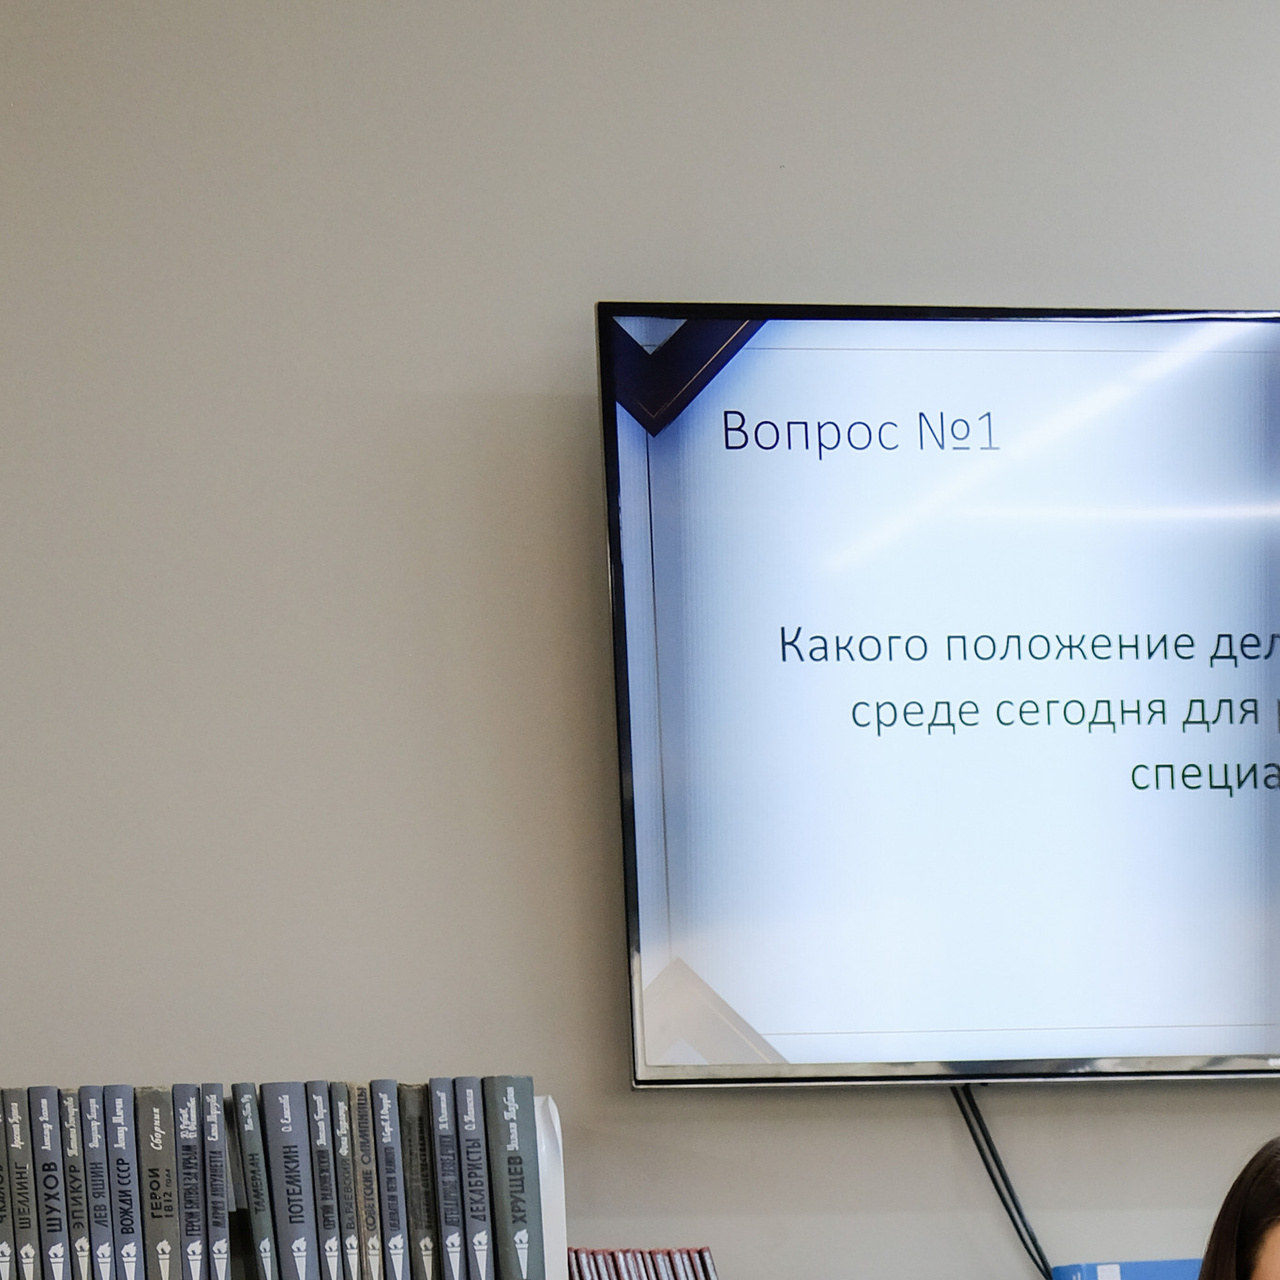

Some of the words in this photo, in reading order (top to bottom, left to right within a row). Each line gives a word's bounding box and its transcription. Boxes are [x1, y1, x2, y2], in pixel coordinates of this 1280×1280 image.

[724, 411, 900, 463] Вопрос
[919, 412, 1000, 452] №1
[780, 627, 928, 663] Какого
[947, 633, 1196, 663] положение
[851, 696, 982, 734] среде
[996, 697, 1168, 732] сегодня
[1182, 697, 1260, 732] для
[15, 1162, 31, 1229] ШЕЛЛИНГ
[43, 1162, 62, 1232] ШУХОВ
[69, 1165, 84, 1229] ЭПИКУР
[90, 1162, 105, 1198] ЯШИН
[117, 1158, 131, 1185] СССР
[148, 1168, 163, 1218] ГЕРОИ
[248, 1153, 266, 1214] ТАМЕРЛАН
[282, 1145, 304, 1224] ПОТЕМКИН
[466, 1138, 486, 1222] ДЕКАБРИСТЫ
[506, 1156, 527, 1224] ХРУЩЕВ
[96, 1204, 108, 1227] ЛЕВ
[119, 1190, 134, 1234] ВОЖДИ
[164, 1192, 173, 1217] 1812
[362, 1170, 377, 1231] СОВЕТСКИЕ
